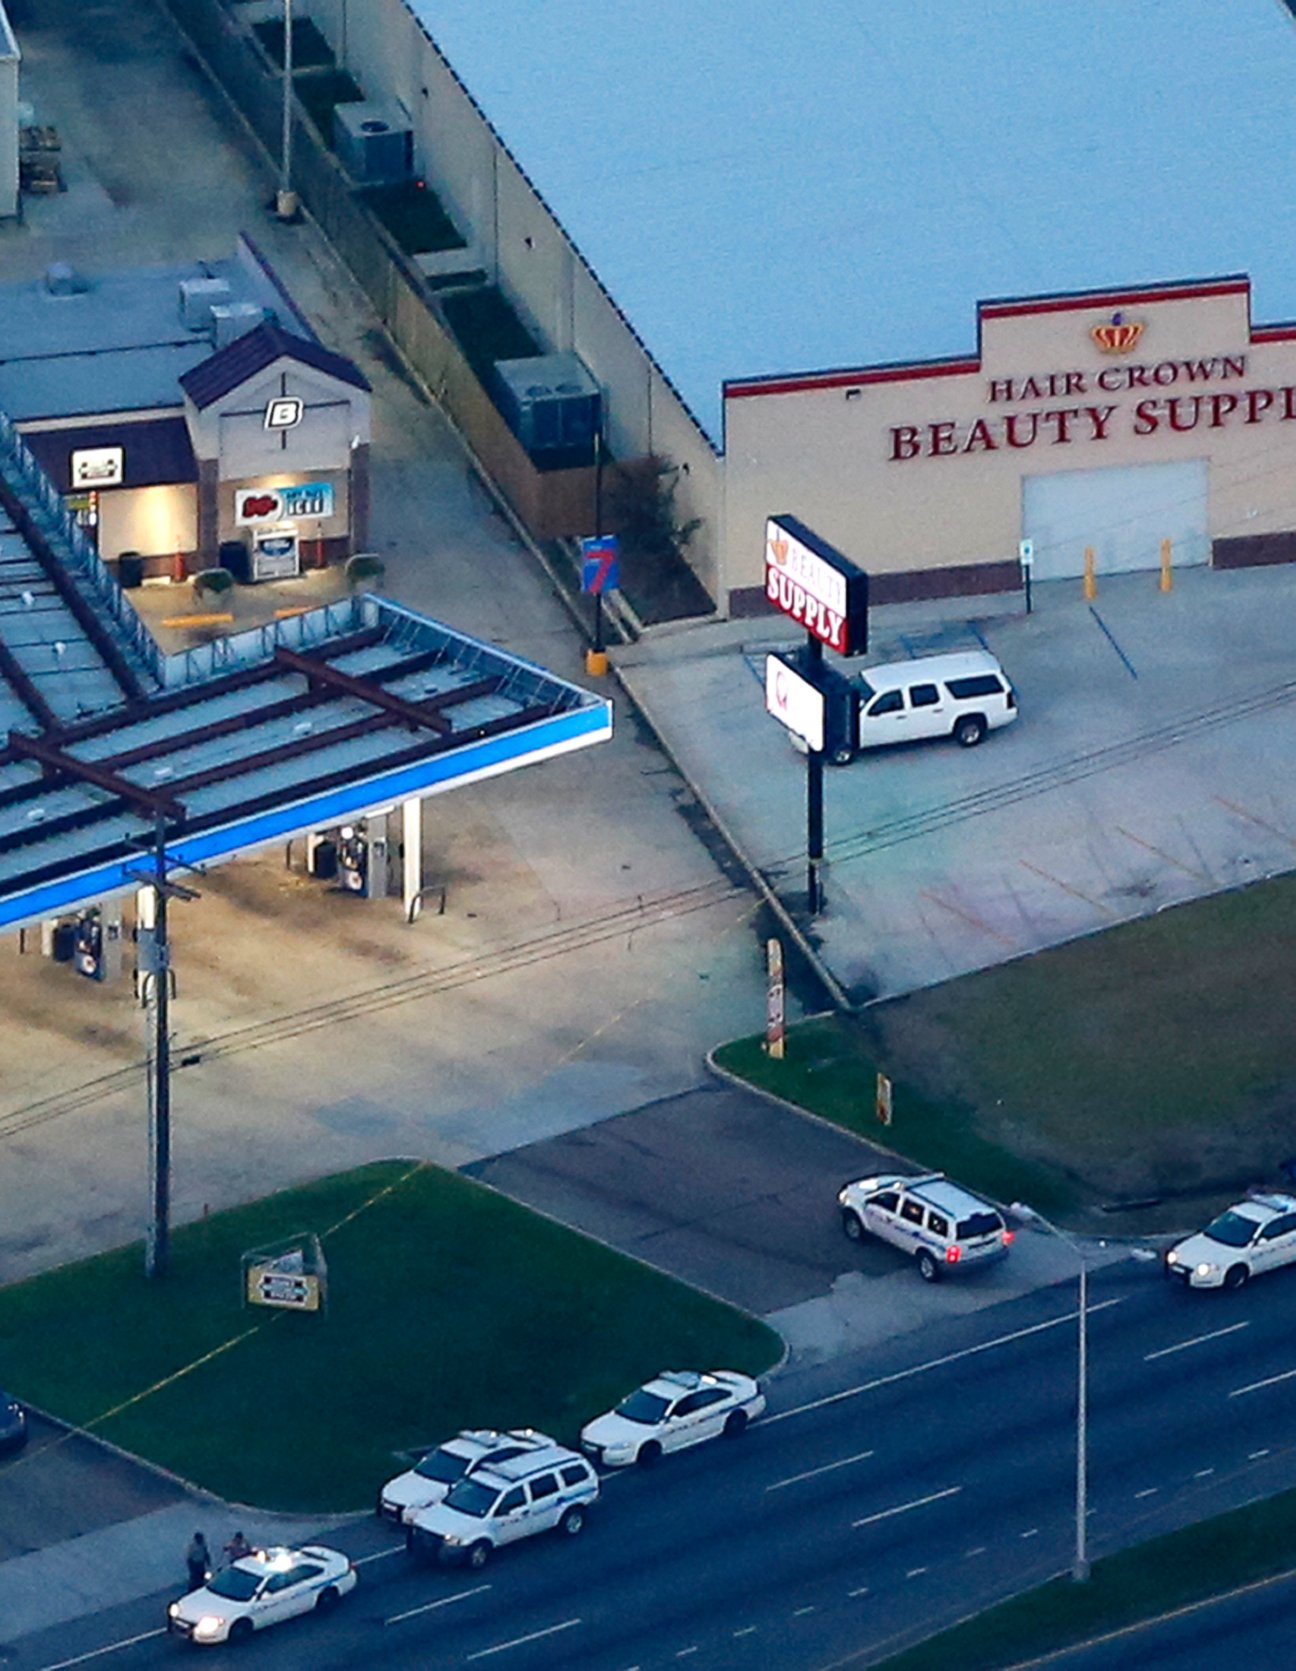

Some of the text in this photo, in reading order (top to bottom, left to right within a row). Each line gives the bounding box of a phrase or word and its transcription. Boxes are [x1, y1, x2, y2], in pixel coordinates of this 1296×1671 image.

[988, 354, 1247, 403] HAIR CROWN
[888, 405, 1118, 461] BEAUTY
[791, 547, 842, 607] BEAUTY
[768, 567, 843, 646] SUPPLY
